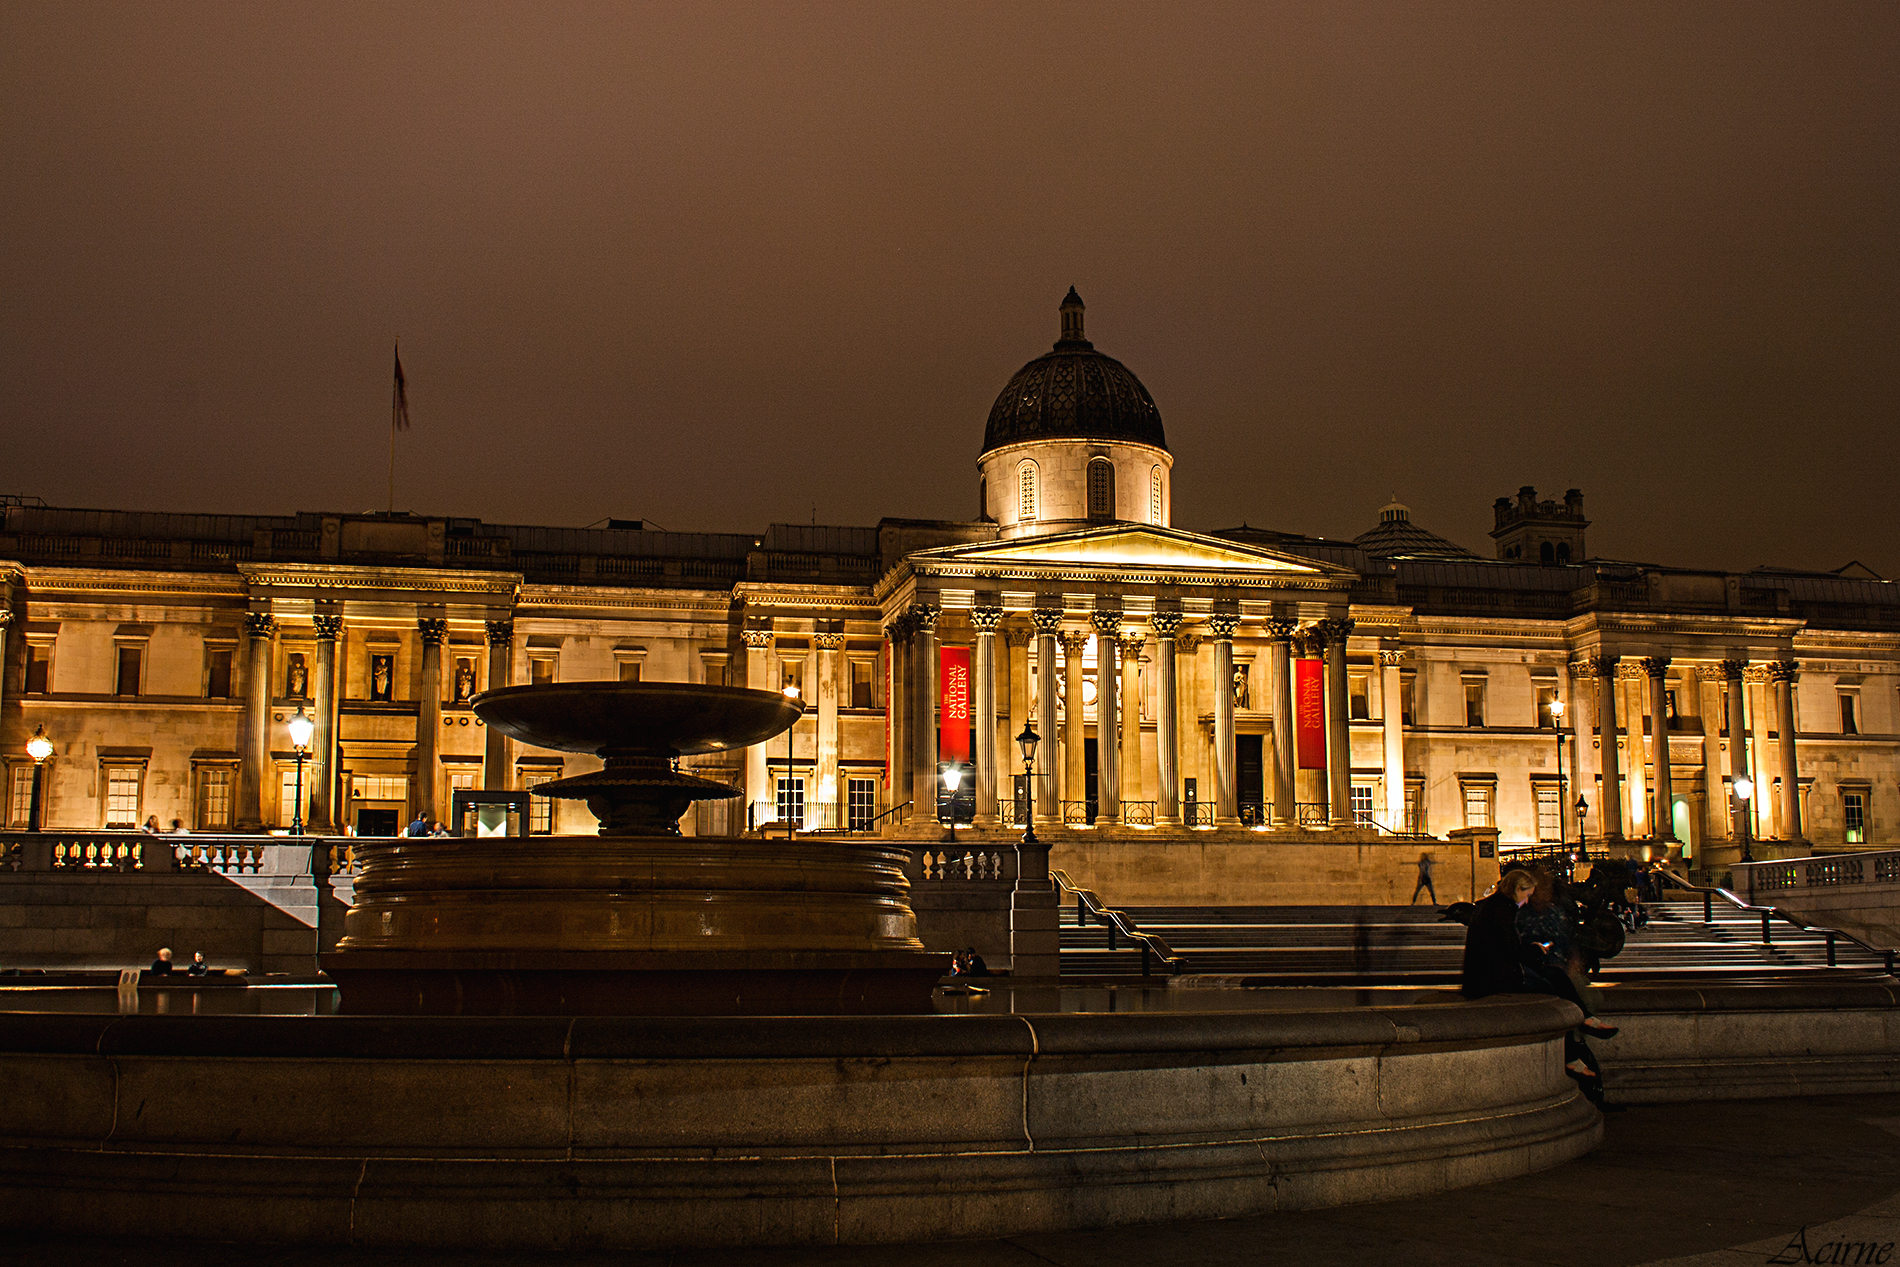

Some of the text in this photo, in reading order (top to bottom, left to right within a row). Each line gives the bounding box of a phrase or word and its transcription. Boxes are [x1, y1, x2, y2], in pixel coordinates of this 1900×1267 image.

[949, 664, 957, 719] NATIONAL
[957, 665, 967, 719] GALLERY
[1303, 675, 1311, 728] NATIONAL
[1311, 676, 1320, 729] GALLERY
